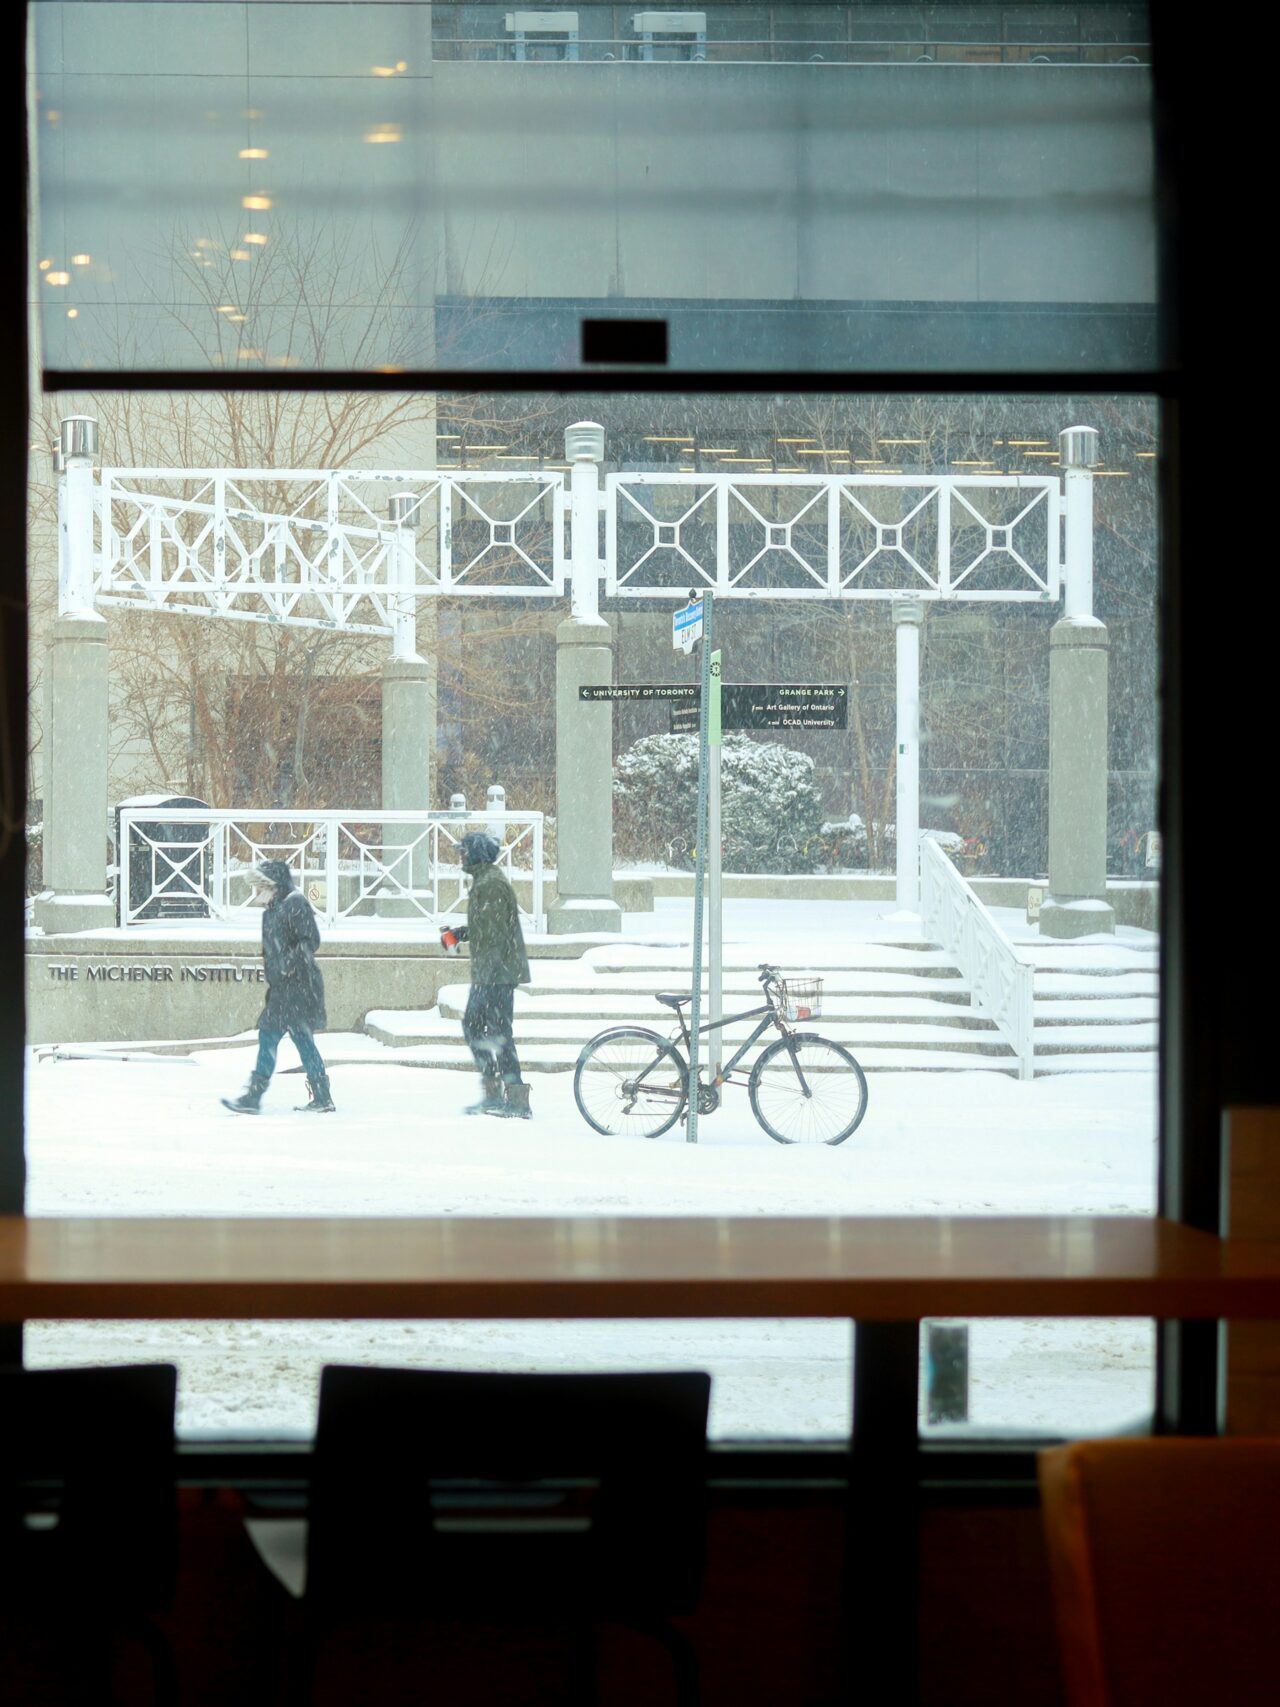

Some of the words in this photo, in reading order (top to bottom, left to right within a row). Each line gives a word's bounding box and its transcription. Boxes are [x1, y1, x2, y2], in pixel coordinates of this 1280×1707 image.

[593, 689, 640, 697] UNIVERSITY
[656, 688, 694, 696] TORONTO
[803, 719, 834, 727] University
[48, 965, 78, 981] THE
[87, 965, 174, 982] MICHENER
[181, 965, 264, 982] INSTITUTE
